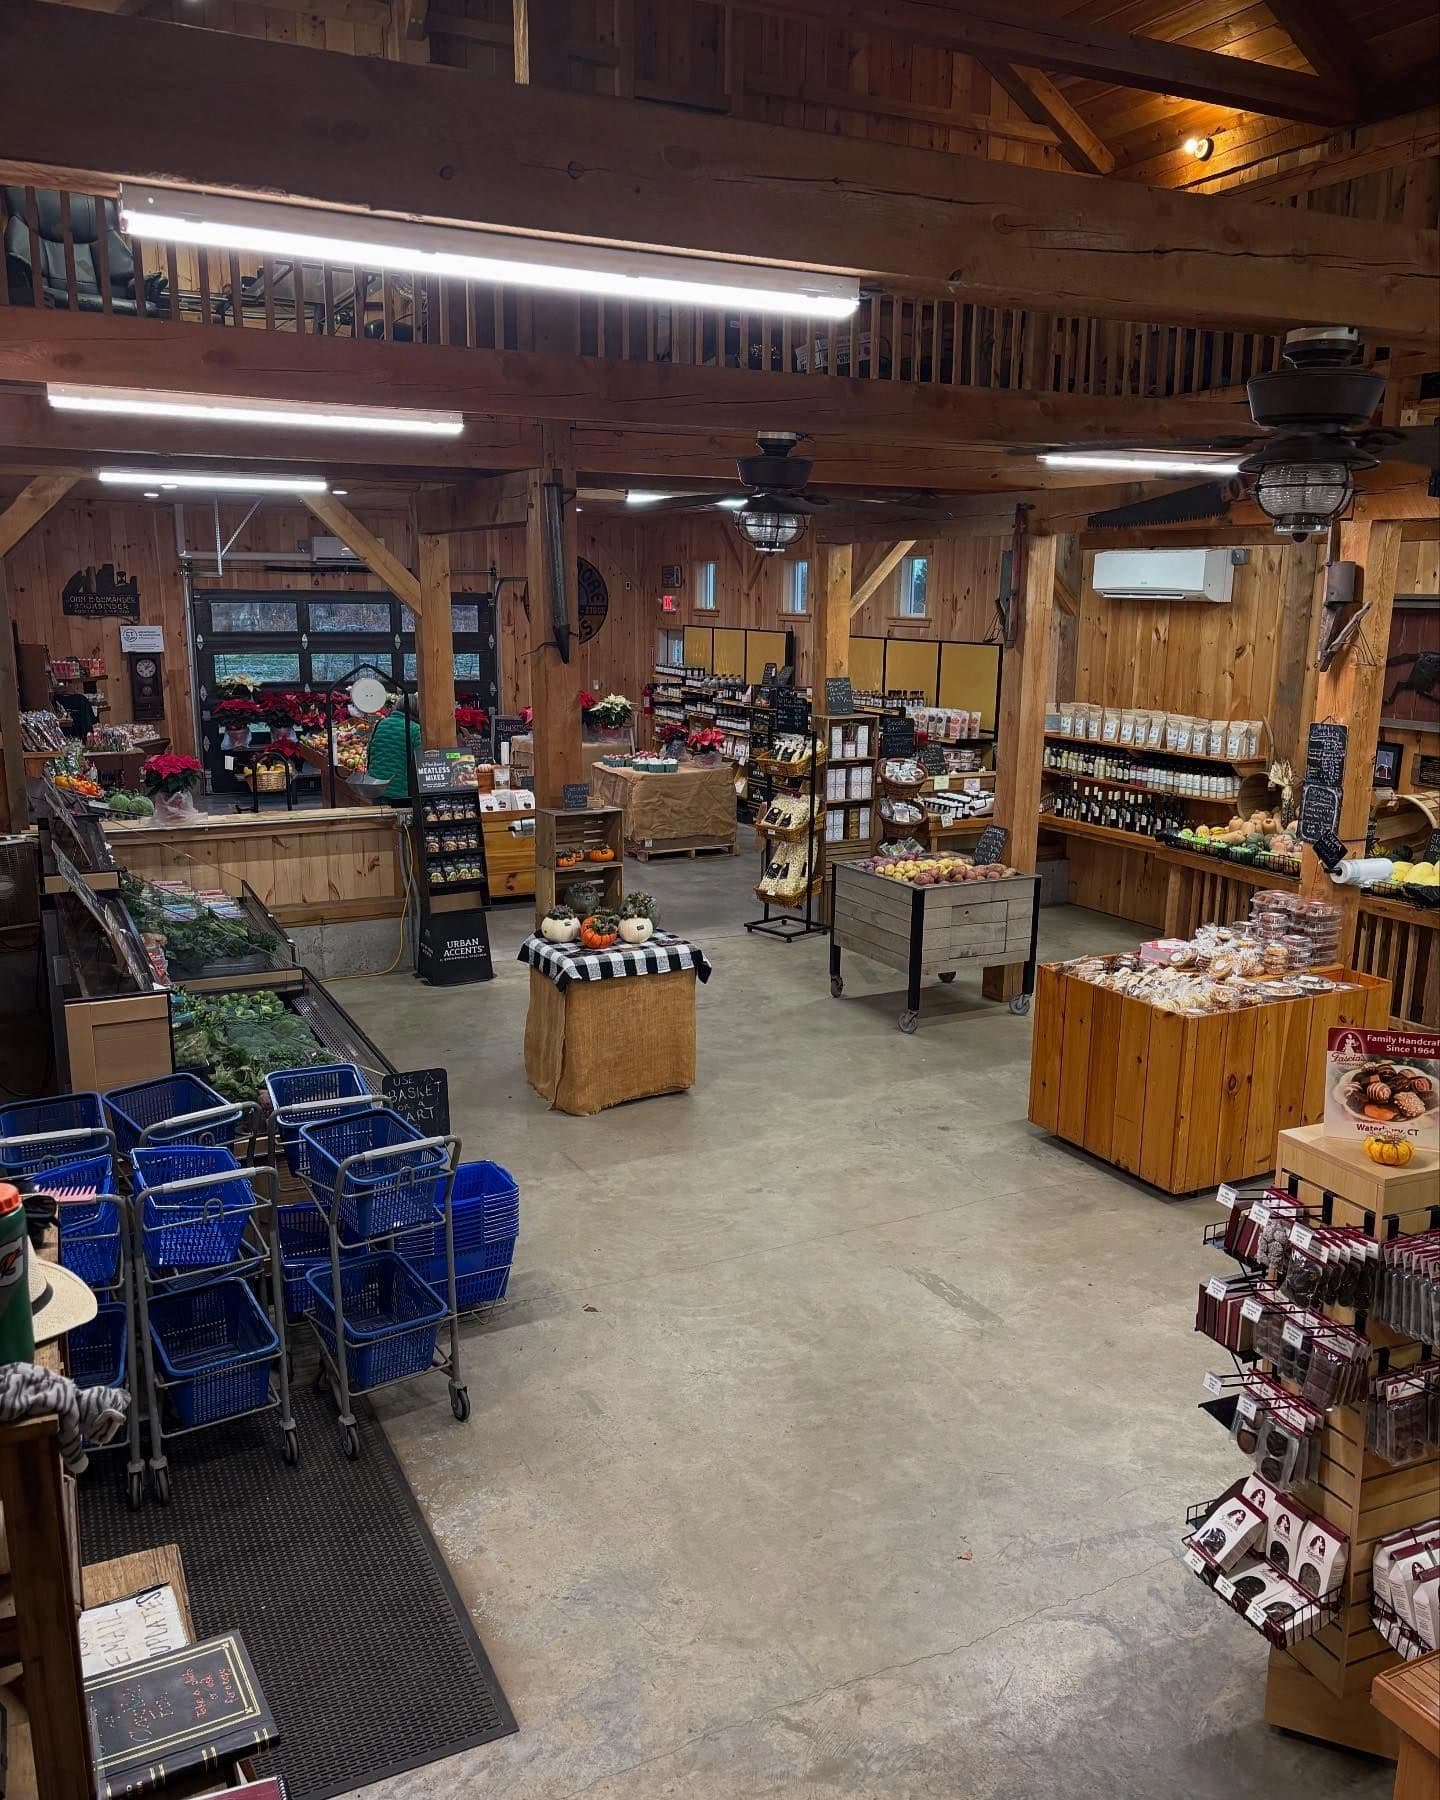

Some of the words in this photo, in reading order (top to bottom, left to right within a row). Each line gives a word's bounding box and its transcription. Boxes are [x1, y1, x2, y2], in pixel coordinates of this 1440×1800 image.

[418, 766, 451, 775] MEATLESS
[446, 938, 479, 949] URBAN
[443, 945, 485, 957] ACCENTS
[1367, 1034, 1397, 1045] Family
[1386, 1044, 1410, 1053] Since
[1412, 1047, 1435, 1055] 1964
[393, 1074, 415, 1087] USE
[388, 1080, 442, 1103] BASKET
[406, 1106, 435, 1122] ART
[1407, 1128, 1420, 1137] CT
[97, 1608, 132, 1667] EMAIL
